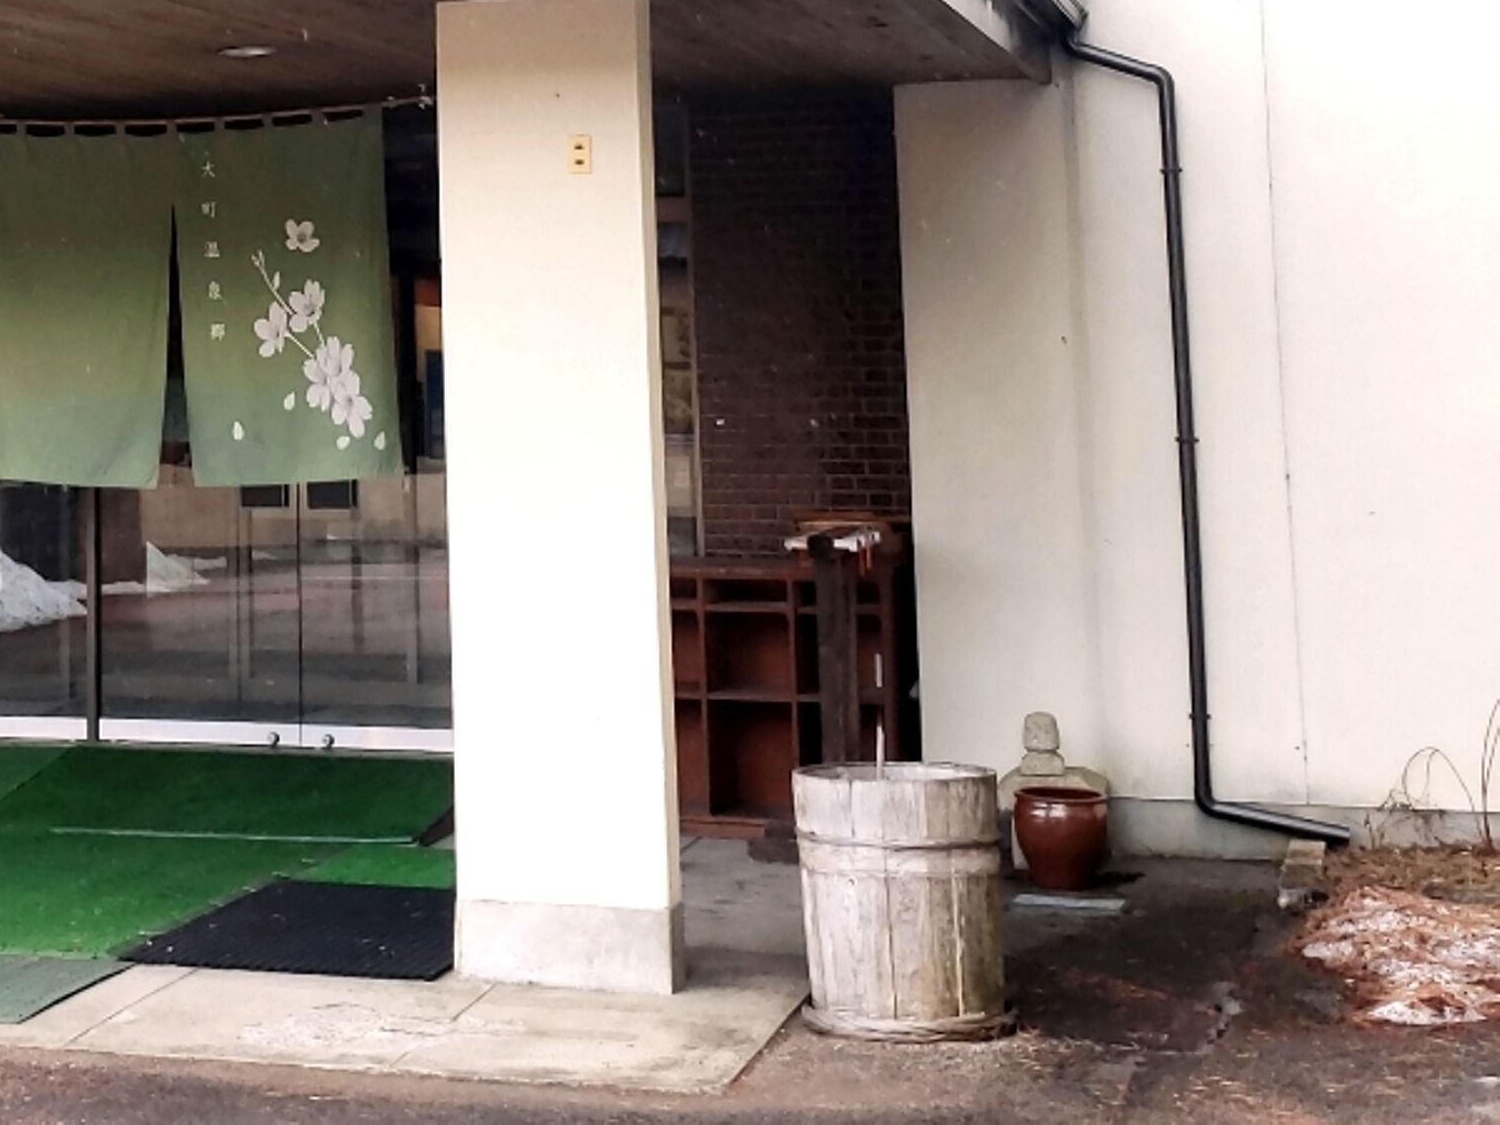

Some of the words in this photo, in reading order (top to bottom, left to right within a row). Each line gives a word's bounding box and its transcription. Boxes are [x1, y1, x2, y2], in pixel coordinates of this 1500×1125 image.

[201, 160, 226, 342] 大町温泉郷
